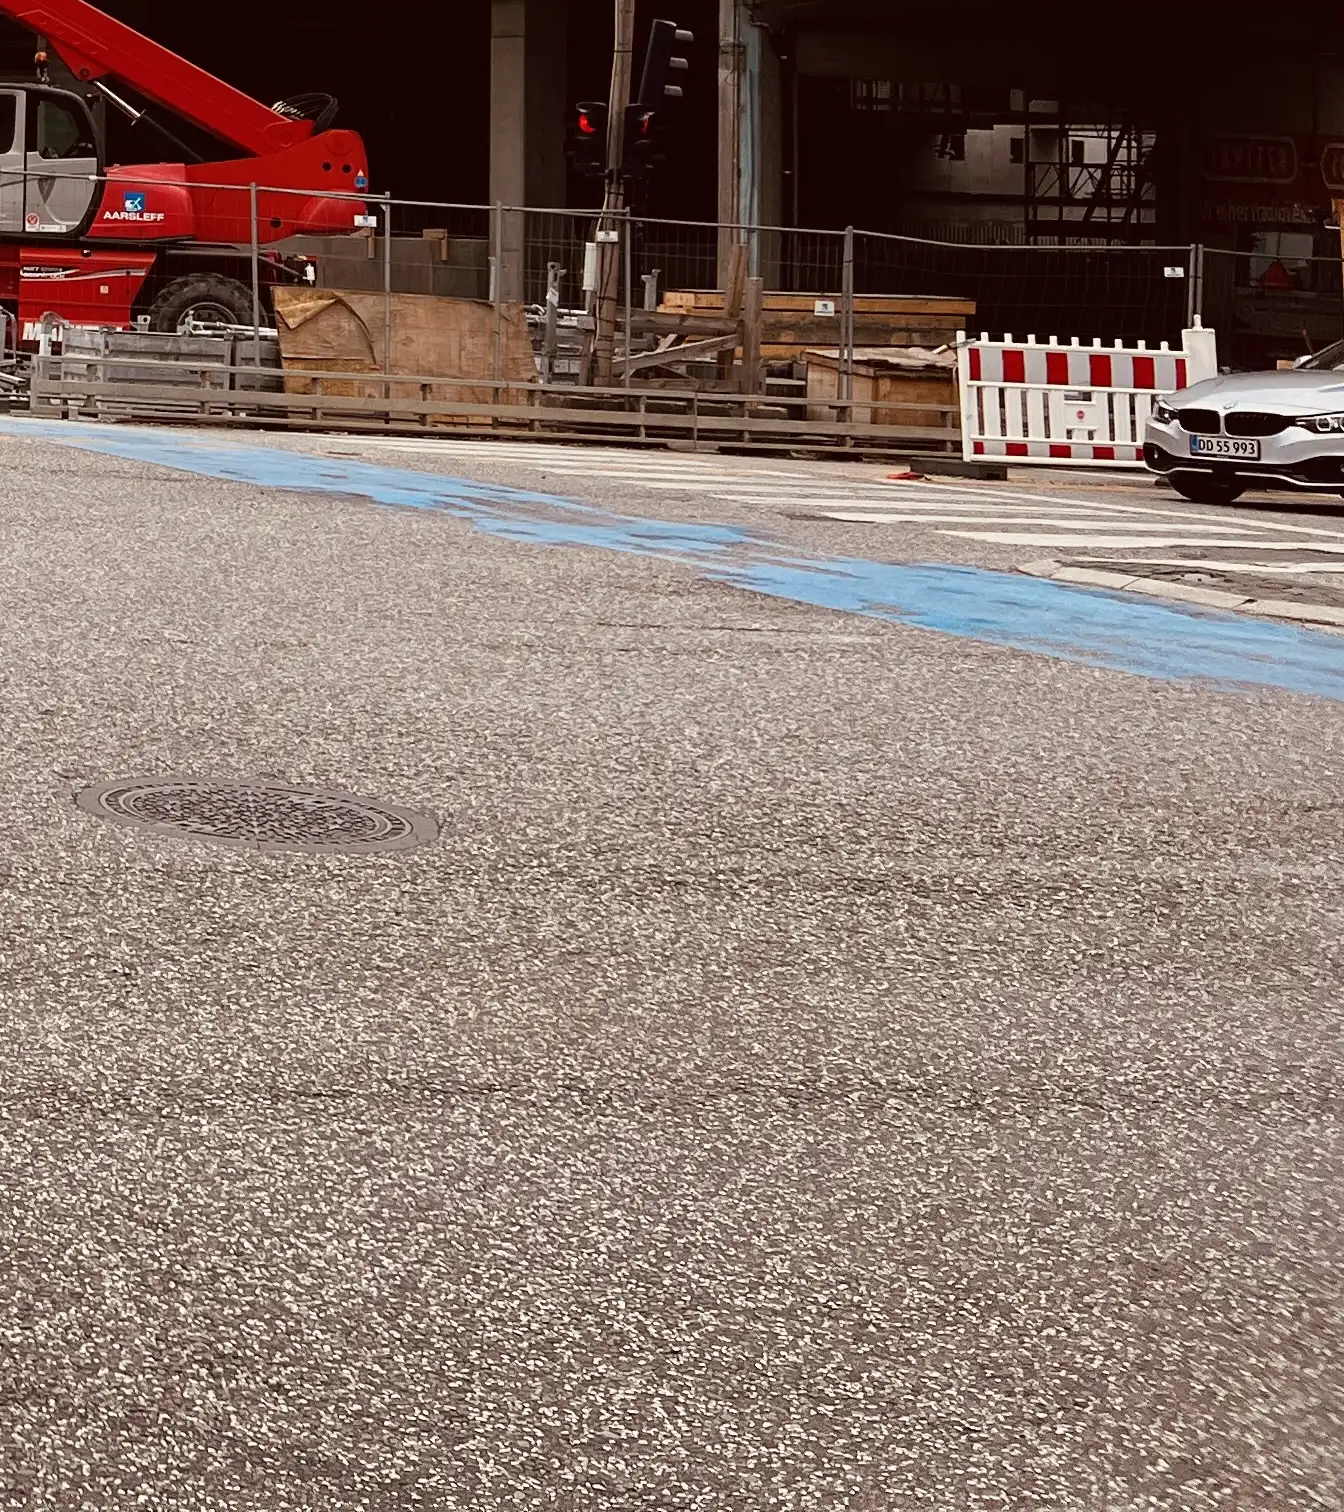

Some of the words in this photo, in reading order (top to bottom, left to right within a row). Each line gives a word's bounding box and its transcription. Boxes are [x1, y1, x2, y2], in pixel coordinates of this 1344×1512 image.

[103, 211, 165, 221] AARSLEFF
[1199, 439, 1213, 451] DD
[1216, 440, 1230, 453] 55
[1233, 442, 1255, 455] 993
